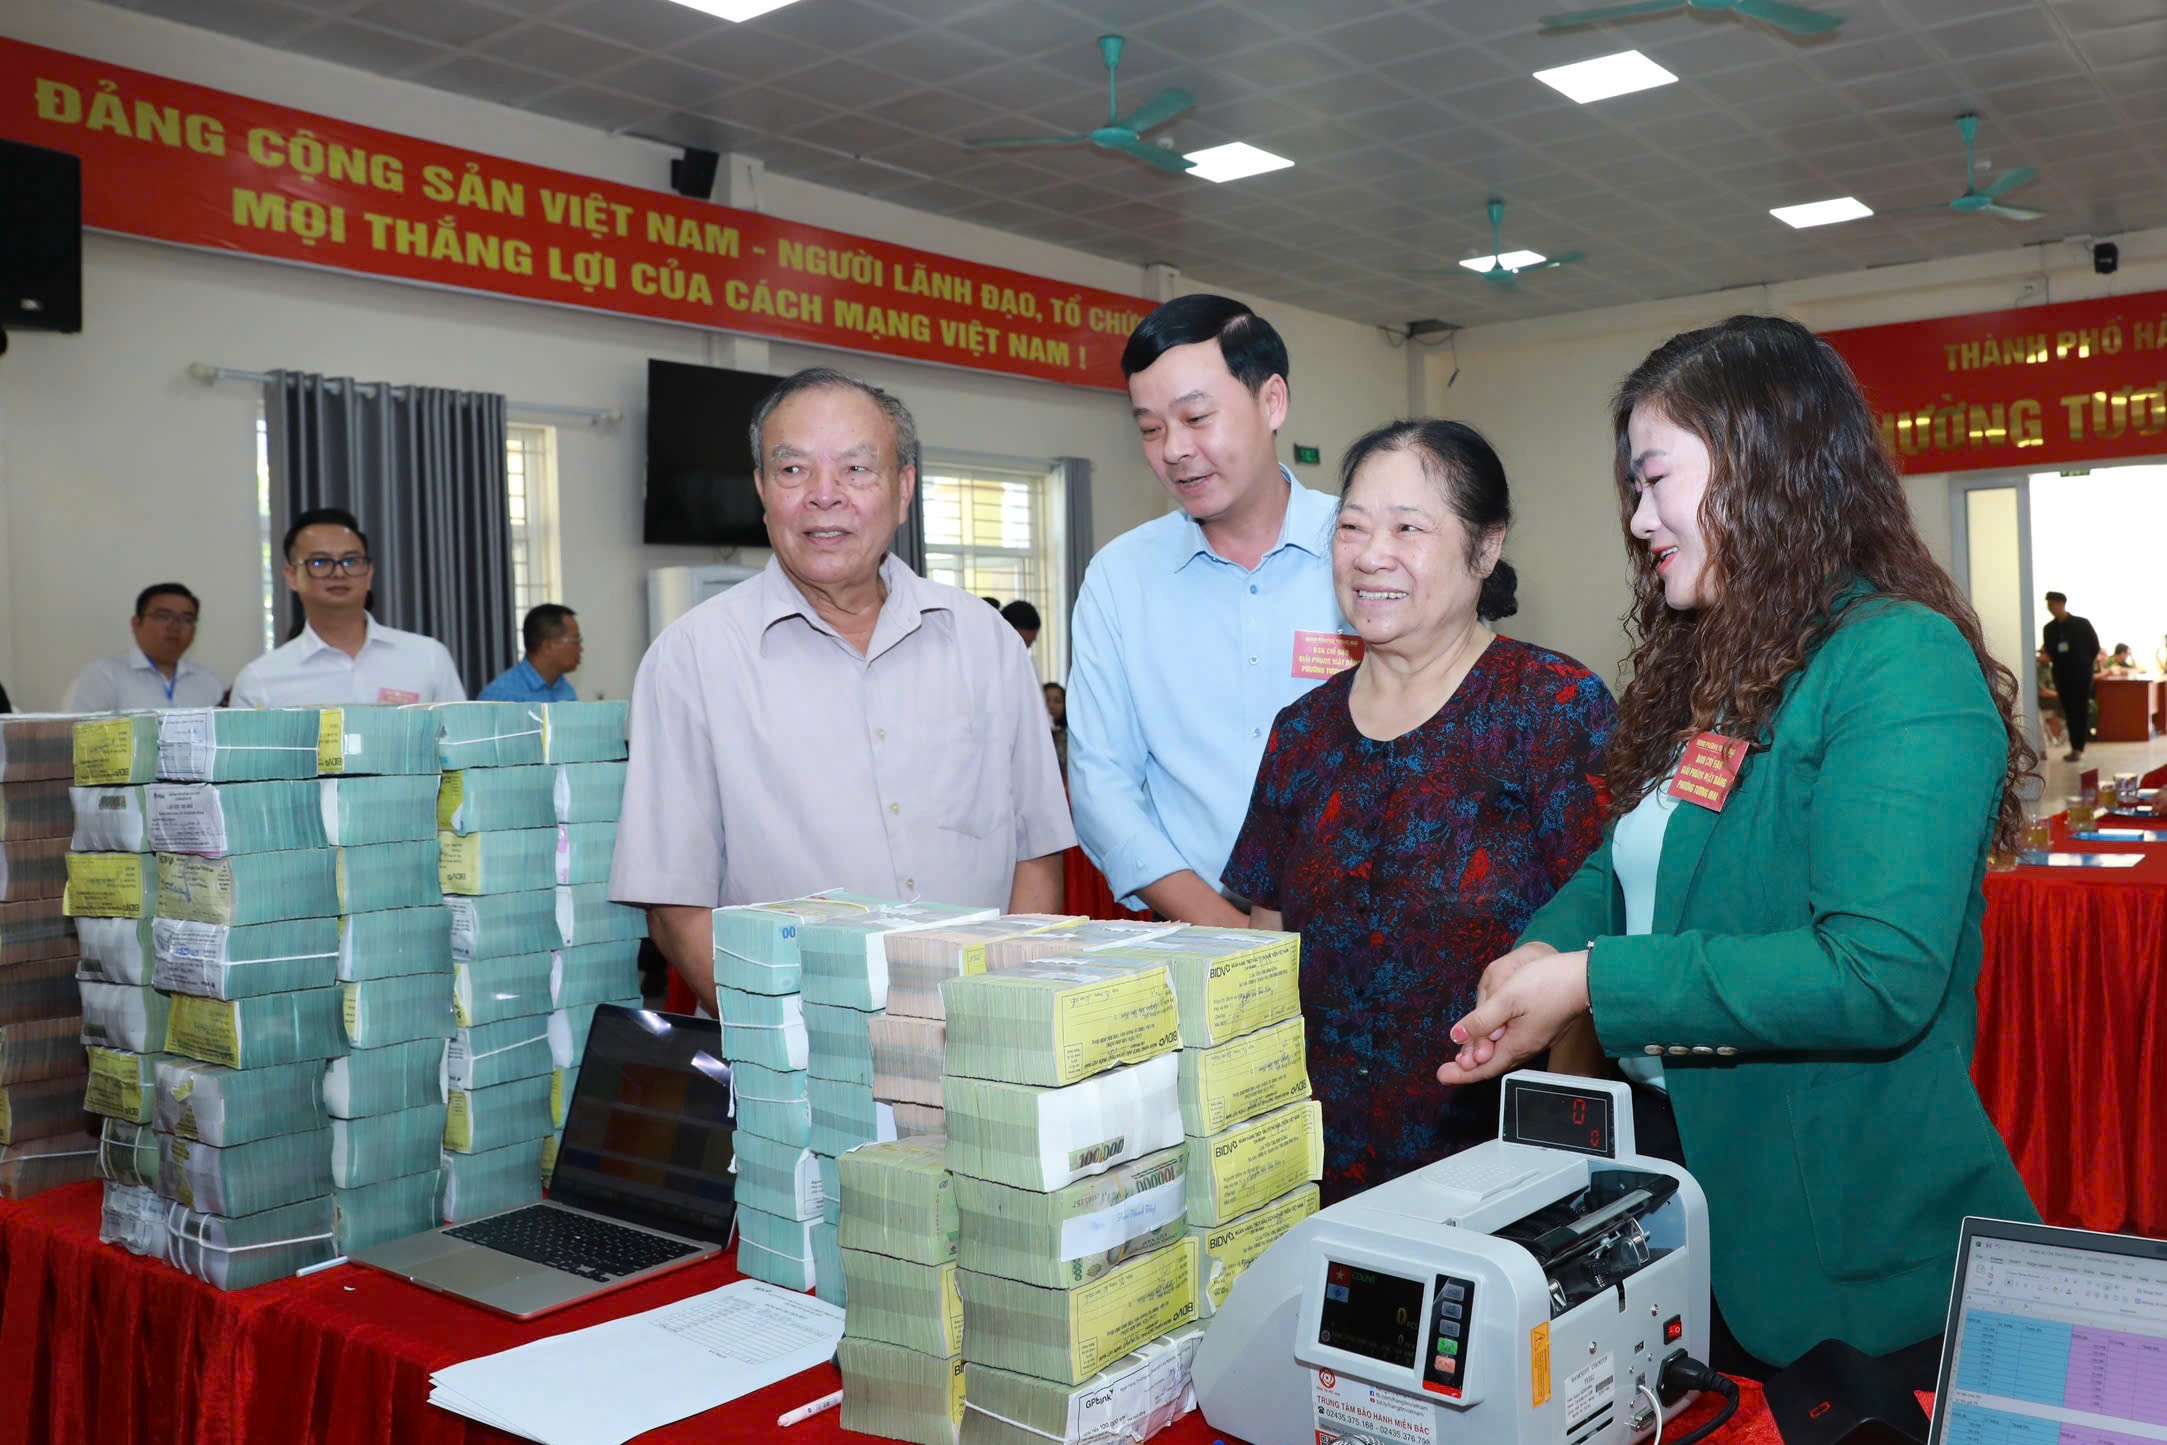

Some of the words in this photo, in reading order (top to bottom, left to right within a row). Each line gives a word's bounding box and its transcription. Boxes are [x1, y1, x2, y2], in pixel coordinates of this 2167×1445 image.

[35, 79, 225, 157] ĐẢNG
[248, 128, 404, 193] CỘNG
[422, 162, 525, 217] SẢN
[539, 193, 634, 239] VIỆT
[647, 211, 740, 258] NAM
[778, 238, 883, 287] NGƯỜI
[894, 263, 973, 305] LÃNH
[981, 284, 1043, 323] ĐẠO,
[1050, 294, 1082, 328] TỔ
[1089, 309, 1142, 337] CHỨ
[232, 188, 346, 246] MỌI
[364, 213, 533, 275] THẮNG
[548, 247, 616, 293] LỢI
[631, 258, 714, 306] CỦA
[725, 280, 822, 324] CÁCH
[834, 299, 931, 343] MẠNG
[940, 319, 1000, 357] VIỆT
[1008, 332, 1071, 368] NAM
[1944, 333, 2048, 372] THÀNH
[2056, 314, 2124, 359] PHỐ
[1883, 394, 2044, 455] ƯỜNG
[1210, 965, 1226, 979] BIDV
[1163, 1030, 1177, 1044] BIDV
[1572, 1099, 1586, 1125] 0
[1216, 1143, 1233, 1158] BIDV
[1210, 1235, 1229, 1250] BIDV
[1177, 1302, 1193, 1318] BIDV
[1316, 1395, 1340, 1409] TRUNG
[1341, 1402, 1356, 1413] TÂM
[1357, 1406, 1372, 1419] BẢO
[1373, 1410, 1393, 1425] HÀNH
[1394, 1415, 1412, 1431] MIỀN
[1414, 1422, 1430, 1436] BẮC
[1326, 1408, 1374, 1431] 02435.375.168
